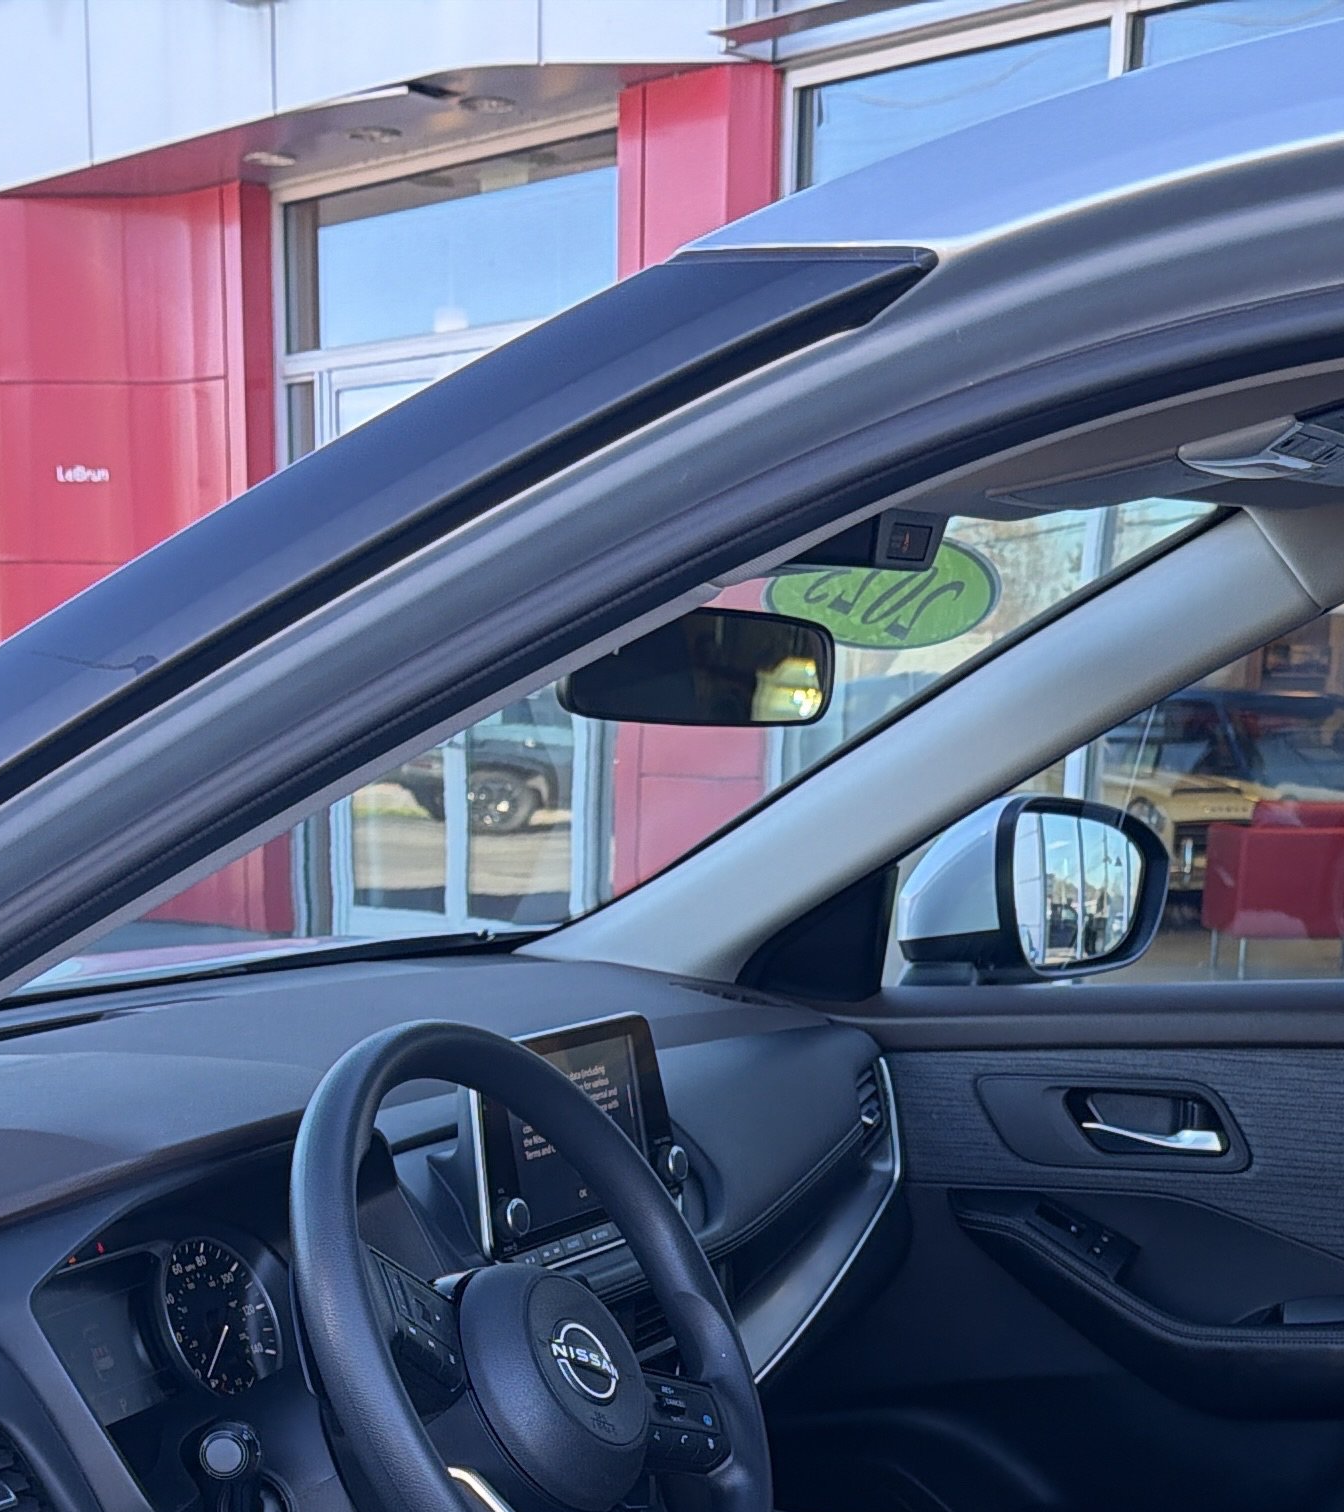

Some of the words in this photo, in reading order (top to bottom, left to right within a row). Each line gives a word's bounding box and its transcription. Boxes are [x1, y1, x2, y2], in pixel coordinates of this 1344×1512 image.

[525, 1149, 541, 1161] Terms
[195, 1255, 206, 1267] 80
[172, 1263, 183, 1275] 60
[220, 1272, 234, 1284] 100
[551, 1341, 619, 1380] NISSAN
